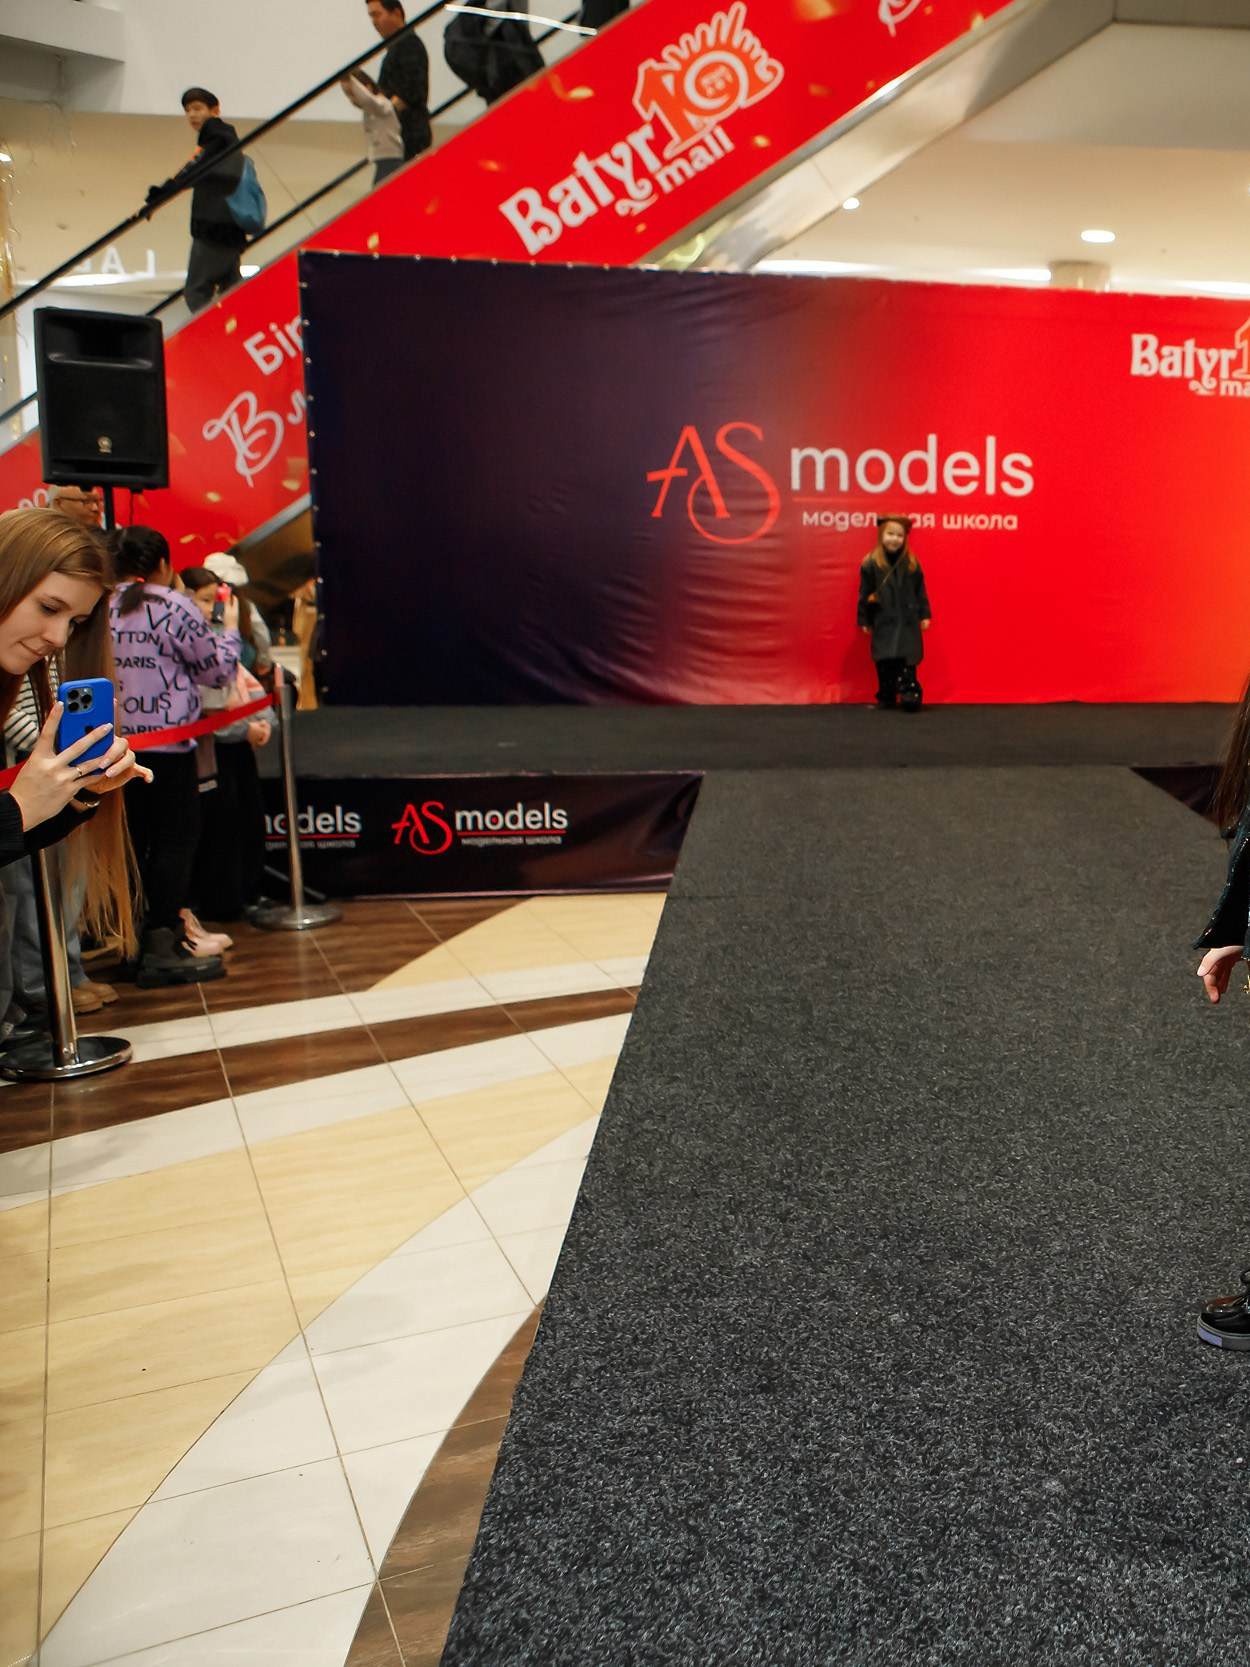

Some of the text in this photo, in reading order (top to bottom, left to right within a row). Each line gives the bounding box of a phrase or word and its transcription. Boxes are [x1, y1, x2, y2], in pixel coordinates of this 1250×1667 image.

[654, 124, 735, 194] mall
[499, 124, 661, 255] Batyr
[1130, 333, 1238, 392] Batyr
[646, 421, 1034, 545] AS models
[802, 510, 1018, 532] моделая школа
[121, 692, 172, 714] OUIS
[391, 801, 568, 855] AS models
